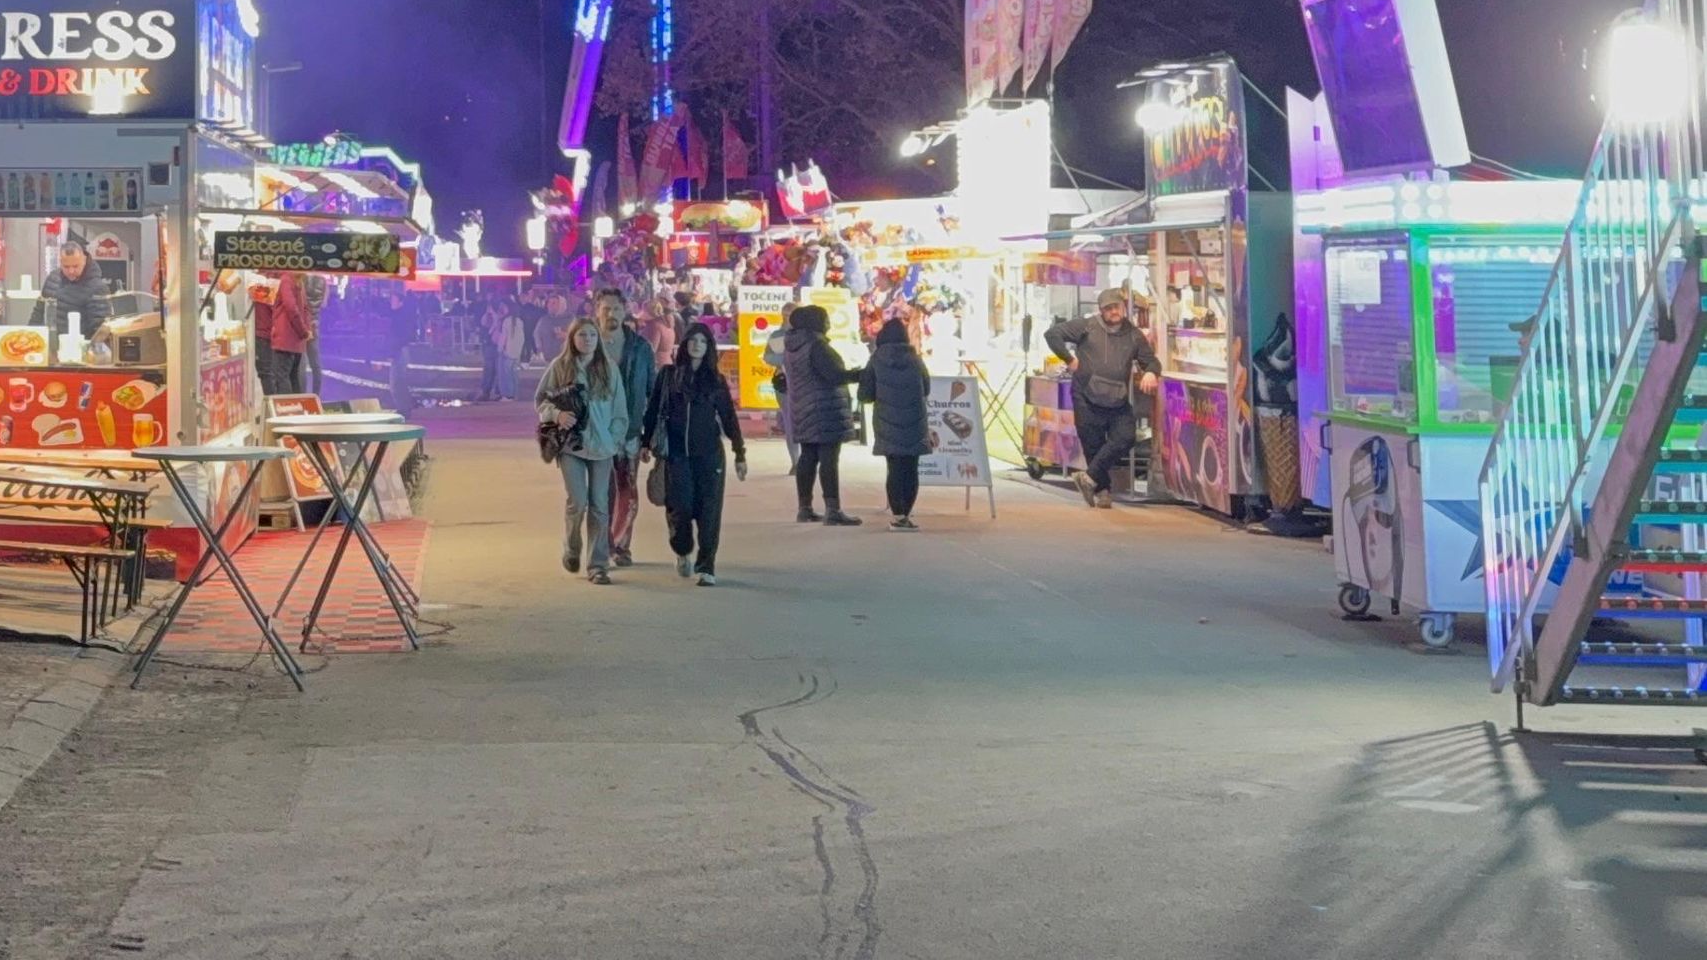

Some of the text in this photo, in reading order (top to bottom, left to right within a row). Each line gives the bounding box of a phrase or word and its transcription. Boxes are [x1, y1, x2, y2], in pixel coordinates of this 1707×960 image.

[29, 67, 151, 96] DRINK
[225, 235, 305, 253] Stáčené
[217, 253, 314, 269] PROSECCO
[743, 290, 787, 301] TOČENÉ
[752, 303, 780, 312] PIVO
